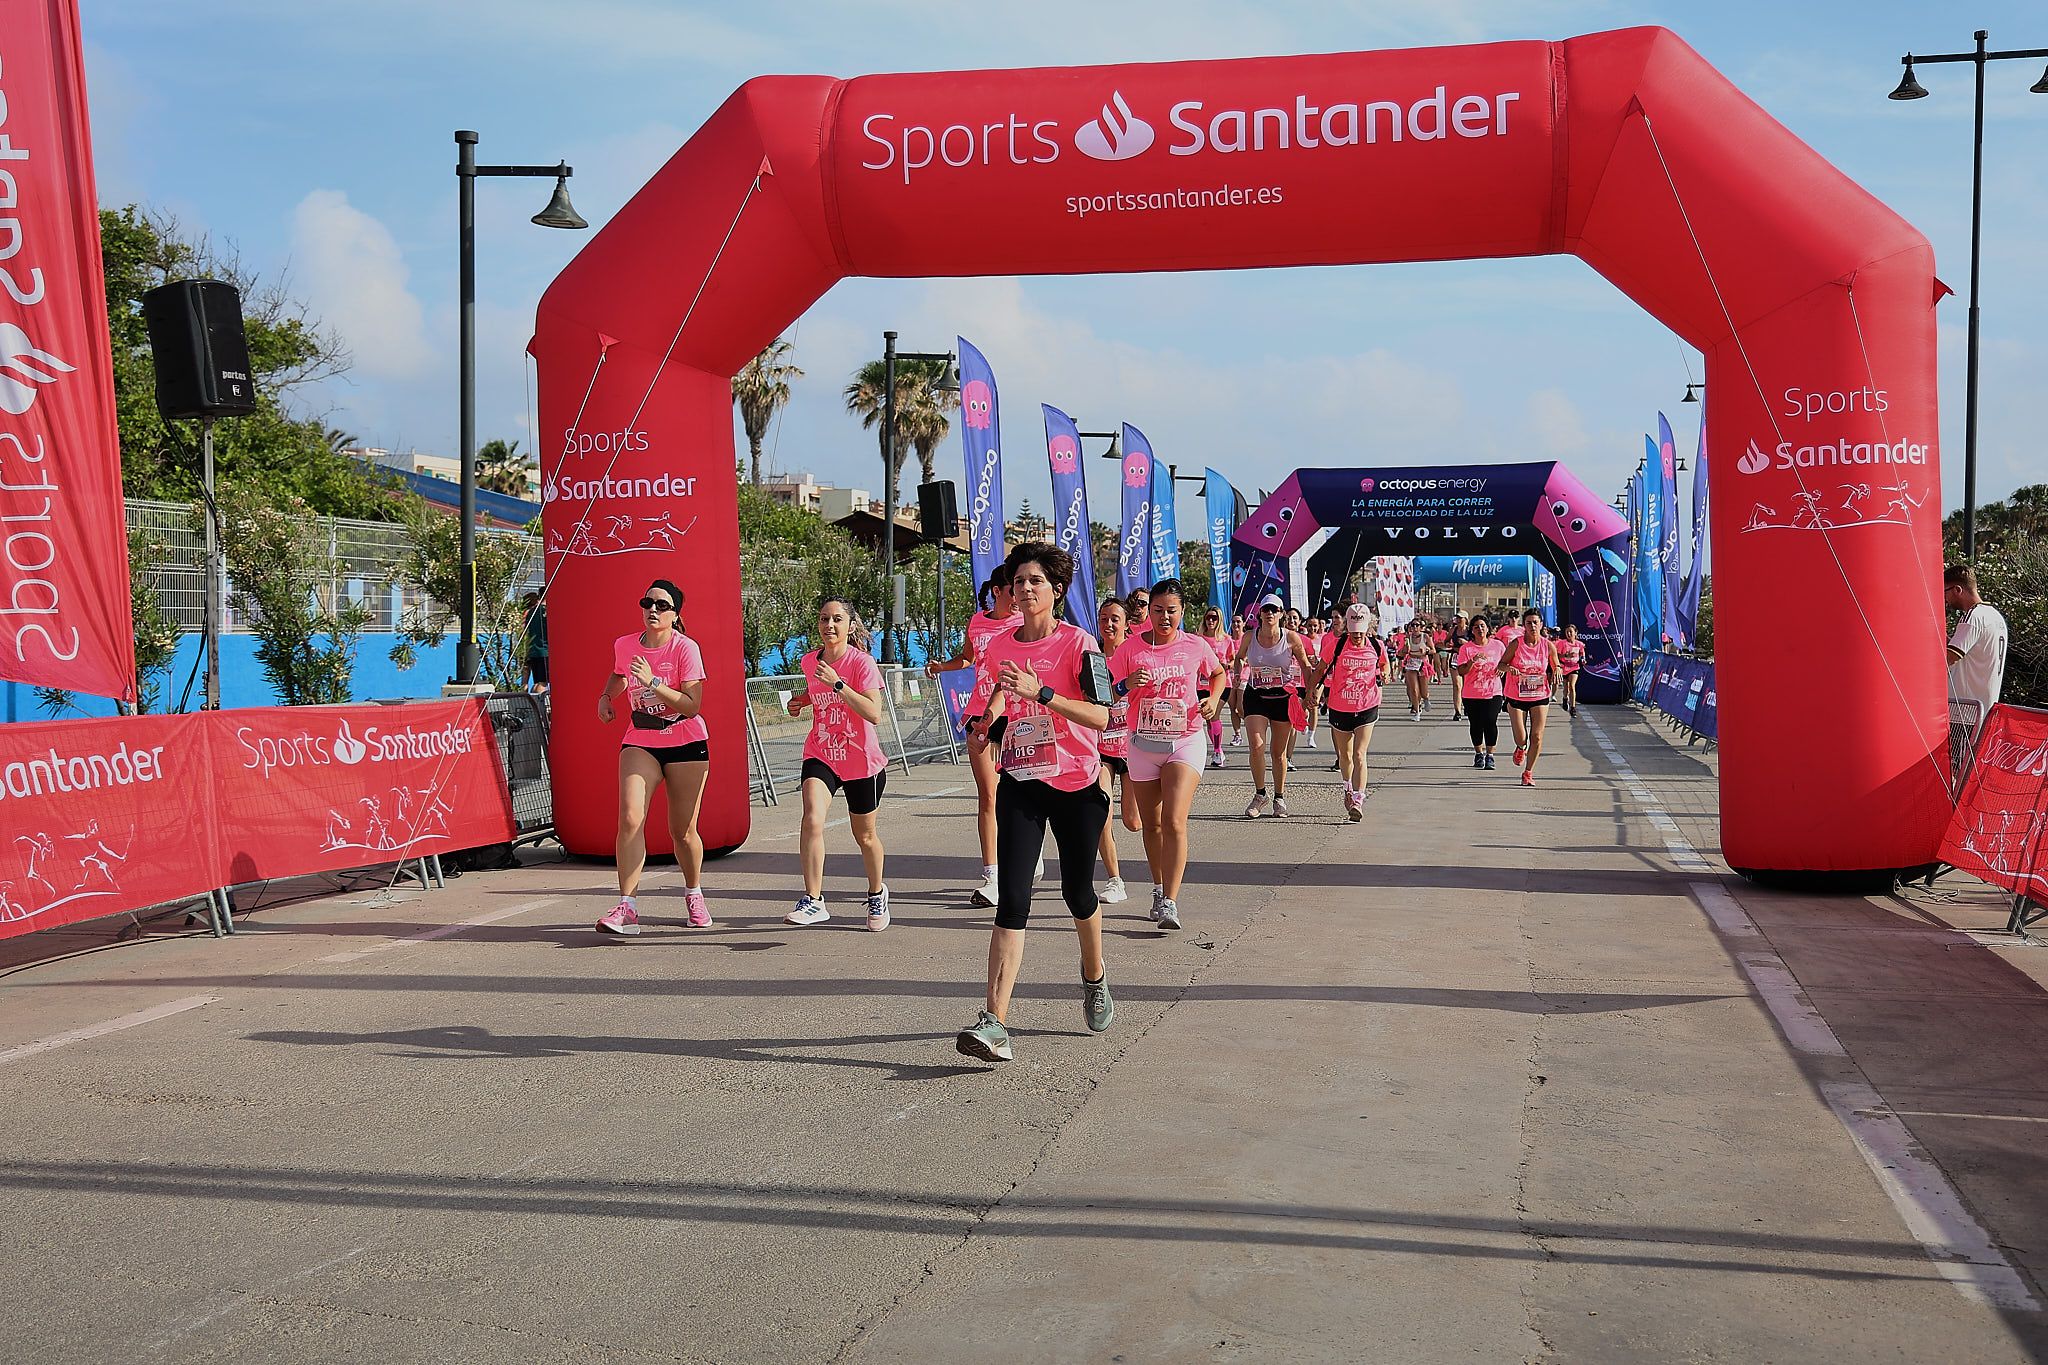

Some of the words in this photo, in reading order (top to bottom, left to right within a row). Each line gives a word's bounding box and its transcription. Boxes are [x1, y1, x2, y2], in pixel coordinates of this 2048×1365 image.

[862, 112, 1060, 185] Sports
[1168, 85, 1520, 157] Santander
[1066, 184, 1283, 218] sportssantander.es
[1784, 385, 1889, 422] Sports
[564, 427, 649, 460] Sports
[1776, 437, 1929, 470] Santander
[561, 472, 697, 501] Santander
[1379, 478, 1437, 492] octopus
[1438, 478, 1487, 493] energy
[1351, 510, 1359, 518] A
[1361, 510, 1375, 518] LA
[1378, 509, 1438, 517] VELOCIDAD
[1440, 509, 1454, 517] DE
[1457, 509, 1471, 517] LA
[1473, 508, 1495, 516] LUZ
[1352, 499, 1365, 508] LA
[1368, 496, 1414, 507] ENERGÍA
[1416, 498, 1445, 507] PARA
[1448, 497, 1492, 506] CORRER
[1384, 525, 1517, 539] VOLVO
[1575, 632, 1600, 641] ctopus
[1147, 665, 1186, 680] ARRERA
[647, 703, 666, 714] 016
[1153, 718, 1172, 727] 016
[237, 725, 330, 779] Sports
[370, 722, 472, 763] Santander
[0, 741, 164, 801] antander
